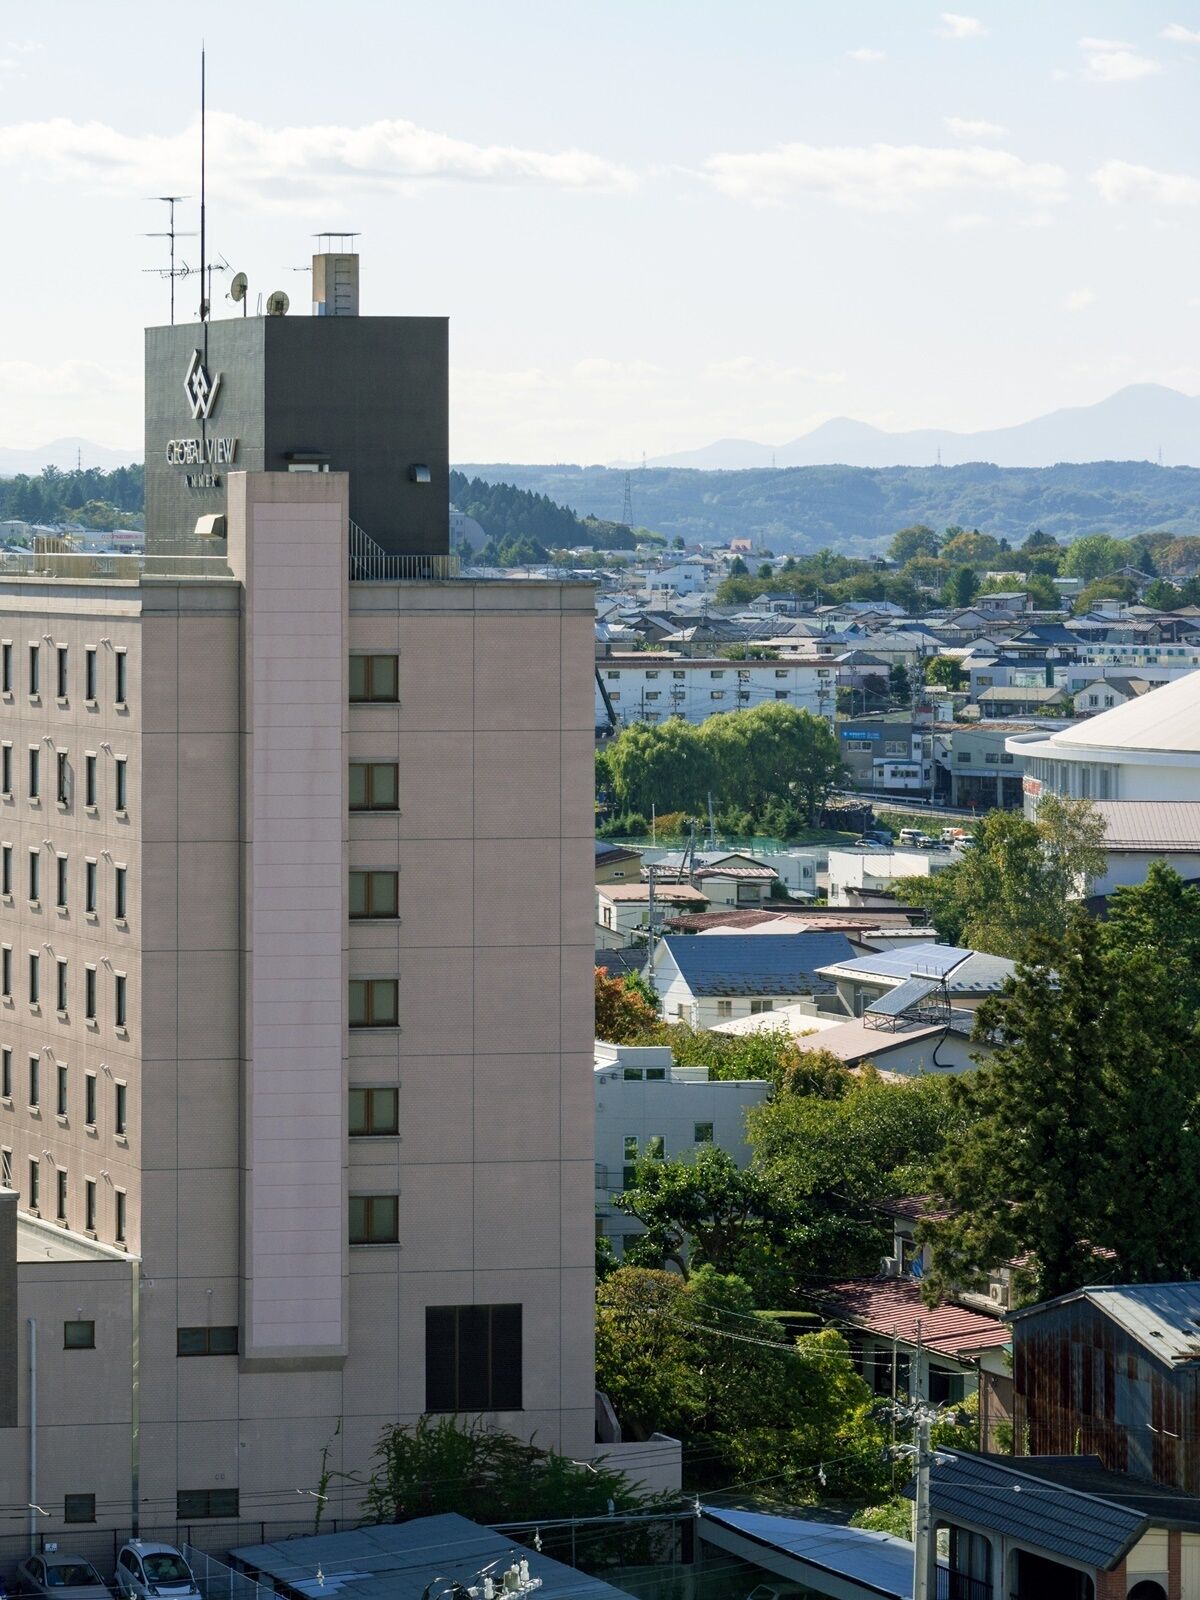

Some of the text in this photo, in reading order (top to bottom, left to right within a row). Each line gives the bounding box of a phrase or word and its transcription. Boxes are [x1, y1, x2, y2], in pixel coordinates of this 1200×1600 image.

[166, 438, 237, 465] GLOBAL VIEW
[184, 473, 218, 488] ANNEX
